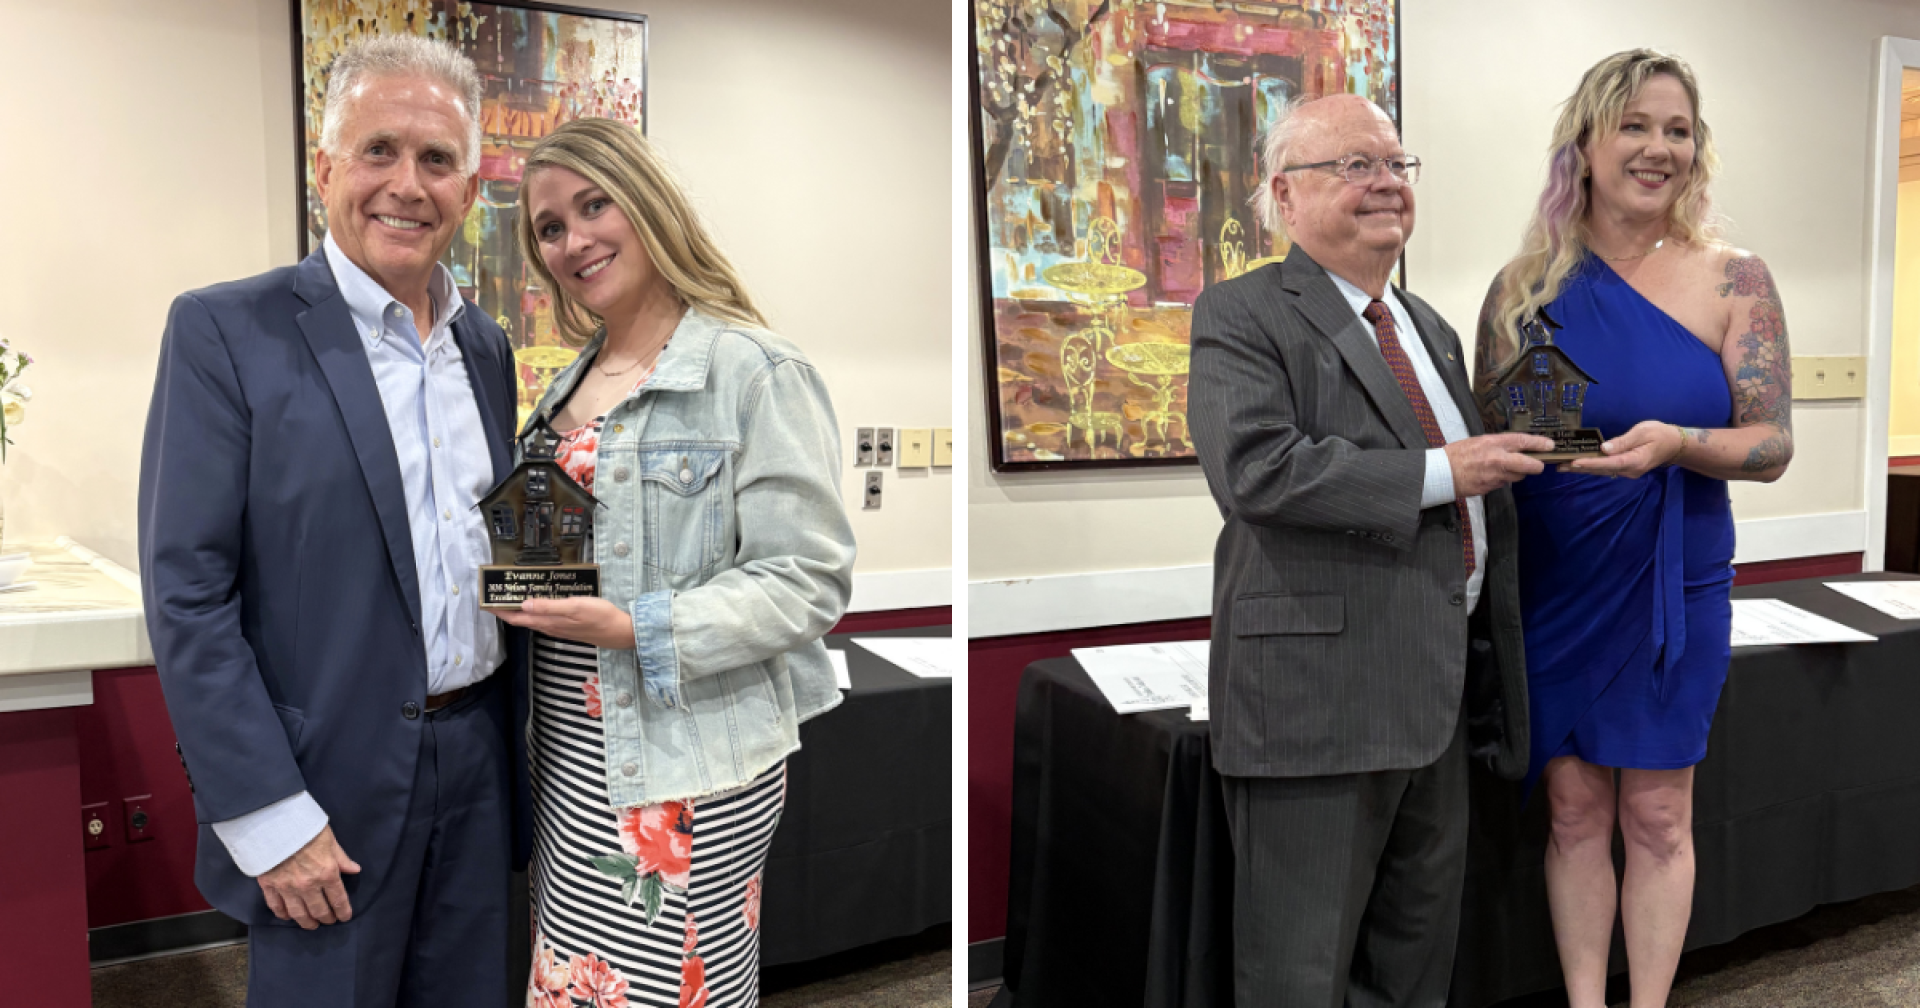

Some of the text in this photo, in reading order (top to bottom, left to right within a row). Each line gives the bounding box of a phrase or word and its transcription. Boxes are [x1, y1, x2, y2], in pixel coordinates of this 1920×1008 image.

[505, 571, 576, 581] Evanne Jones
[528, 583, 552, 593] Family
[554, 582, 593, 592] Foundation
